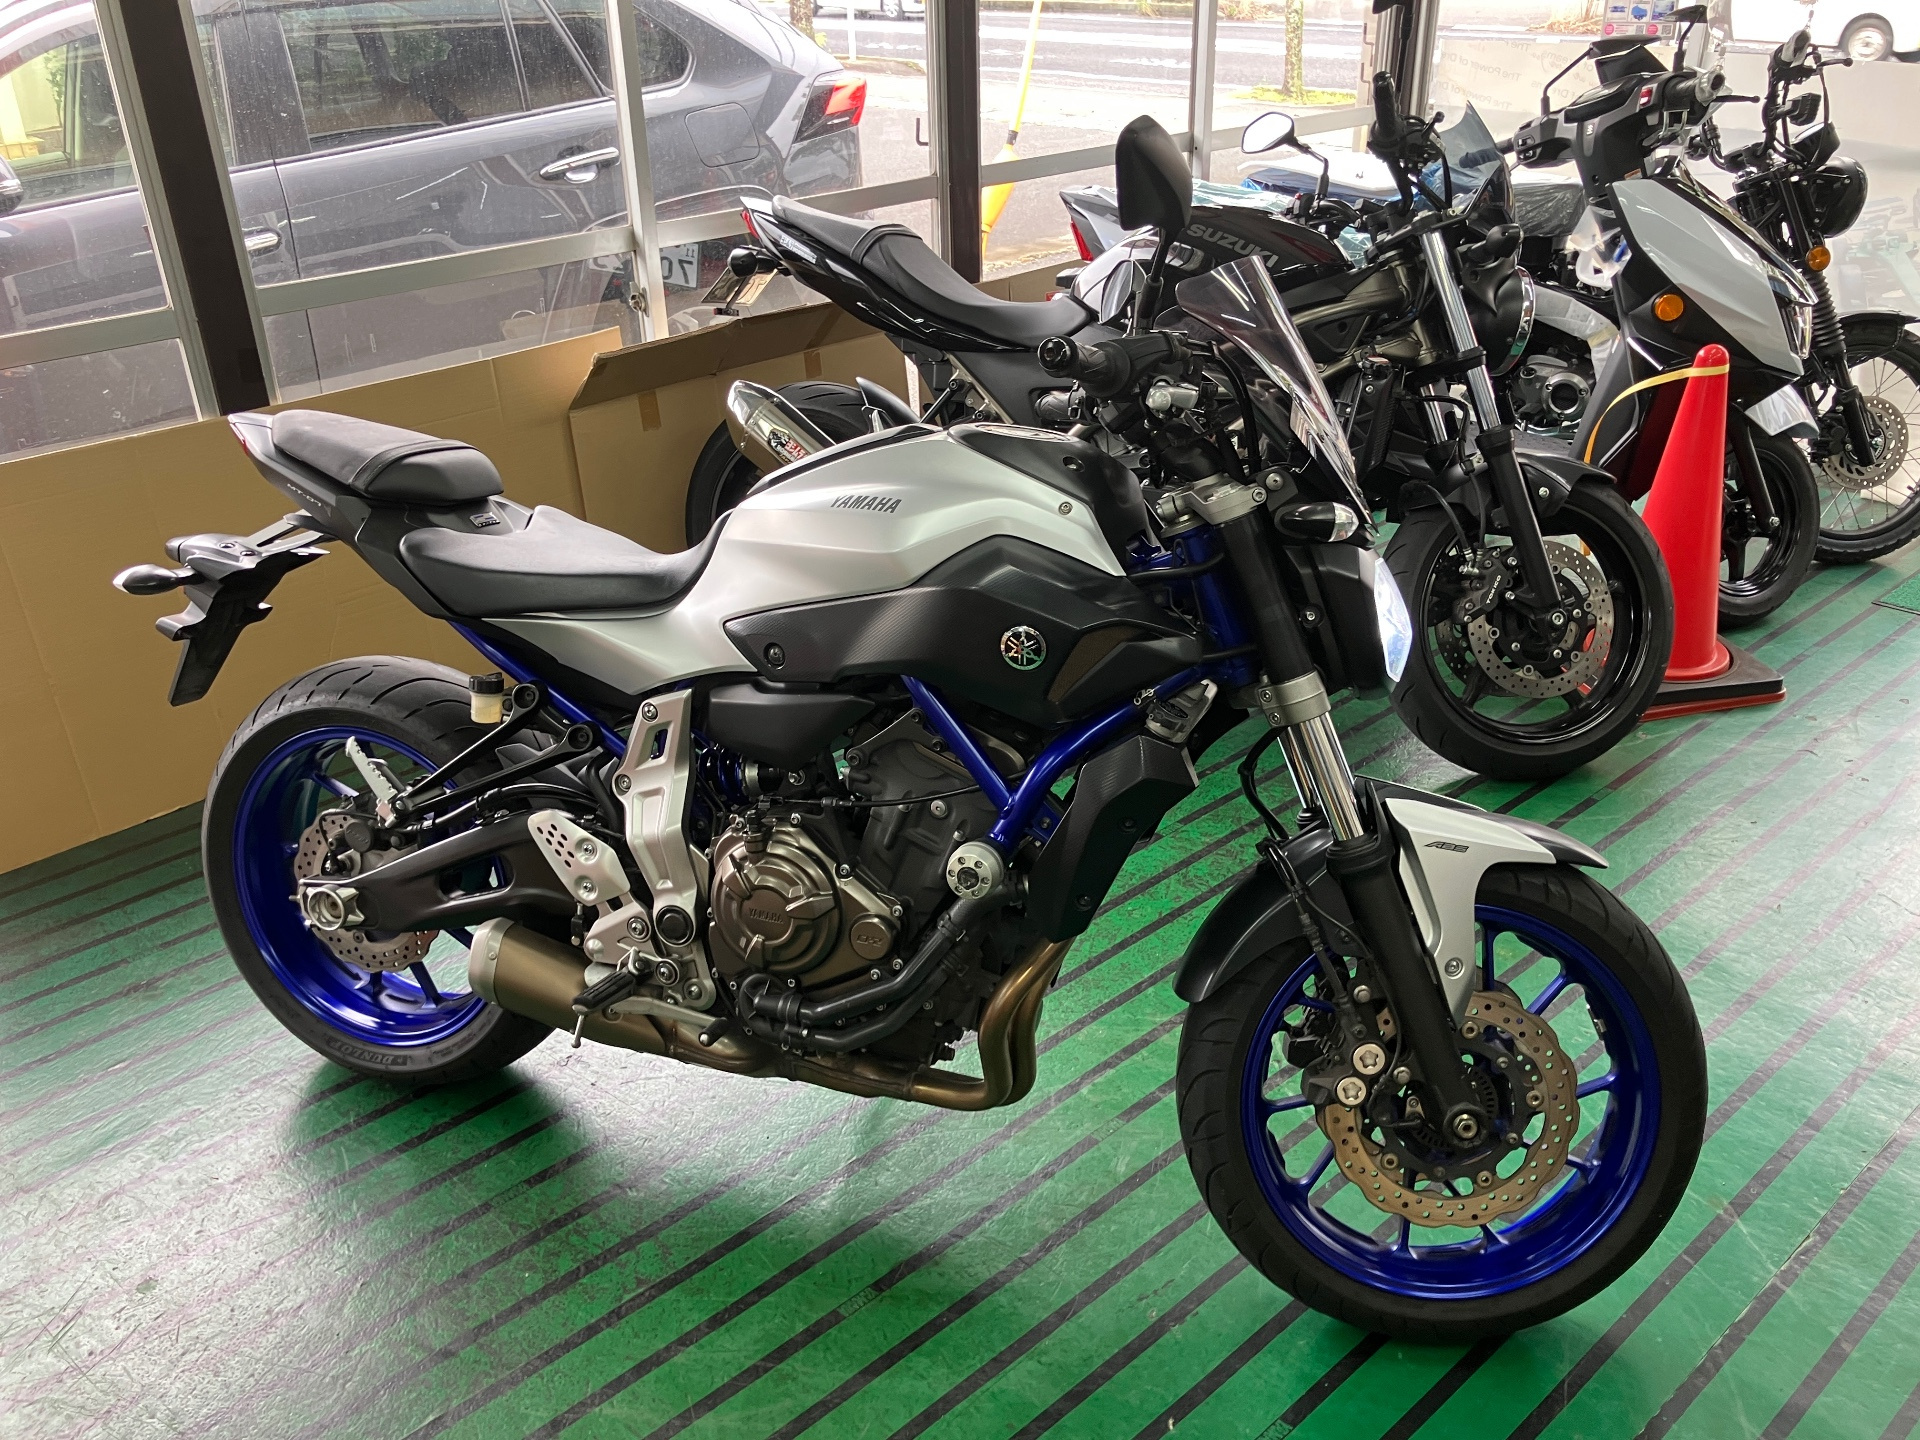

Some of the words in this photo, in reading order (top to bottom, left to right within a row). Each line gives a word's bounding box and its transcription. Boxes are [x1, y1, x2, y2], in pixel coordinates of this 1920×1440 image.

[1186, 223, 1279, 268] SUZUKI
[830, 495, 902, 513] YAMAHA
[1486, 574, 1502, 604] TOKICO
